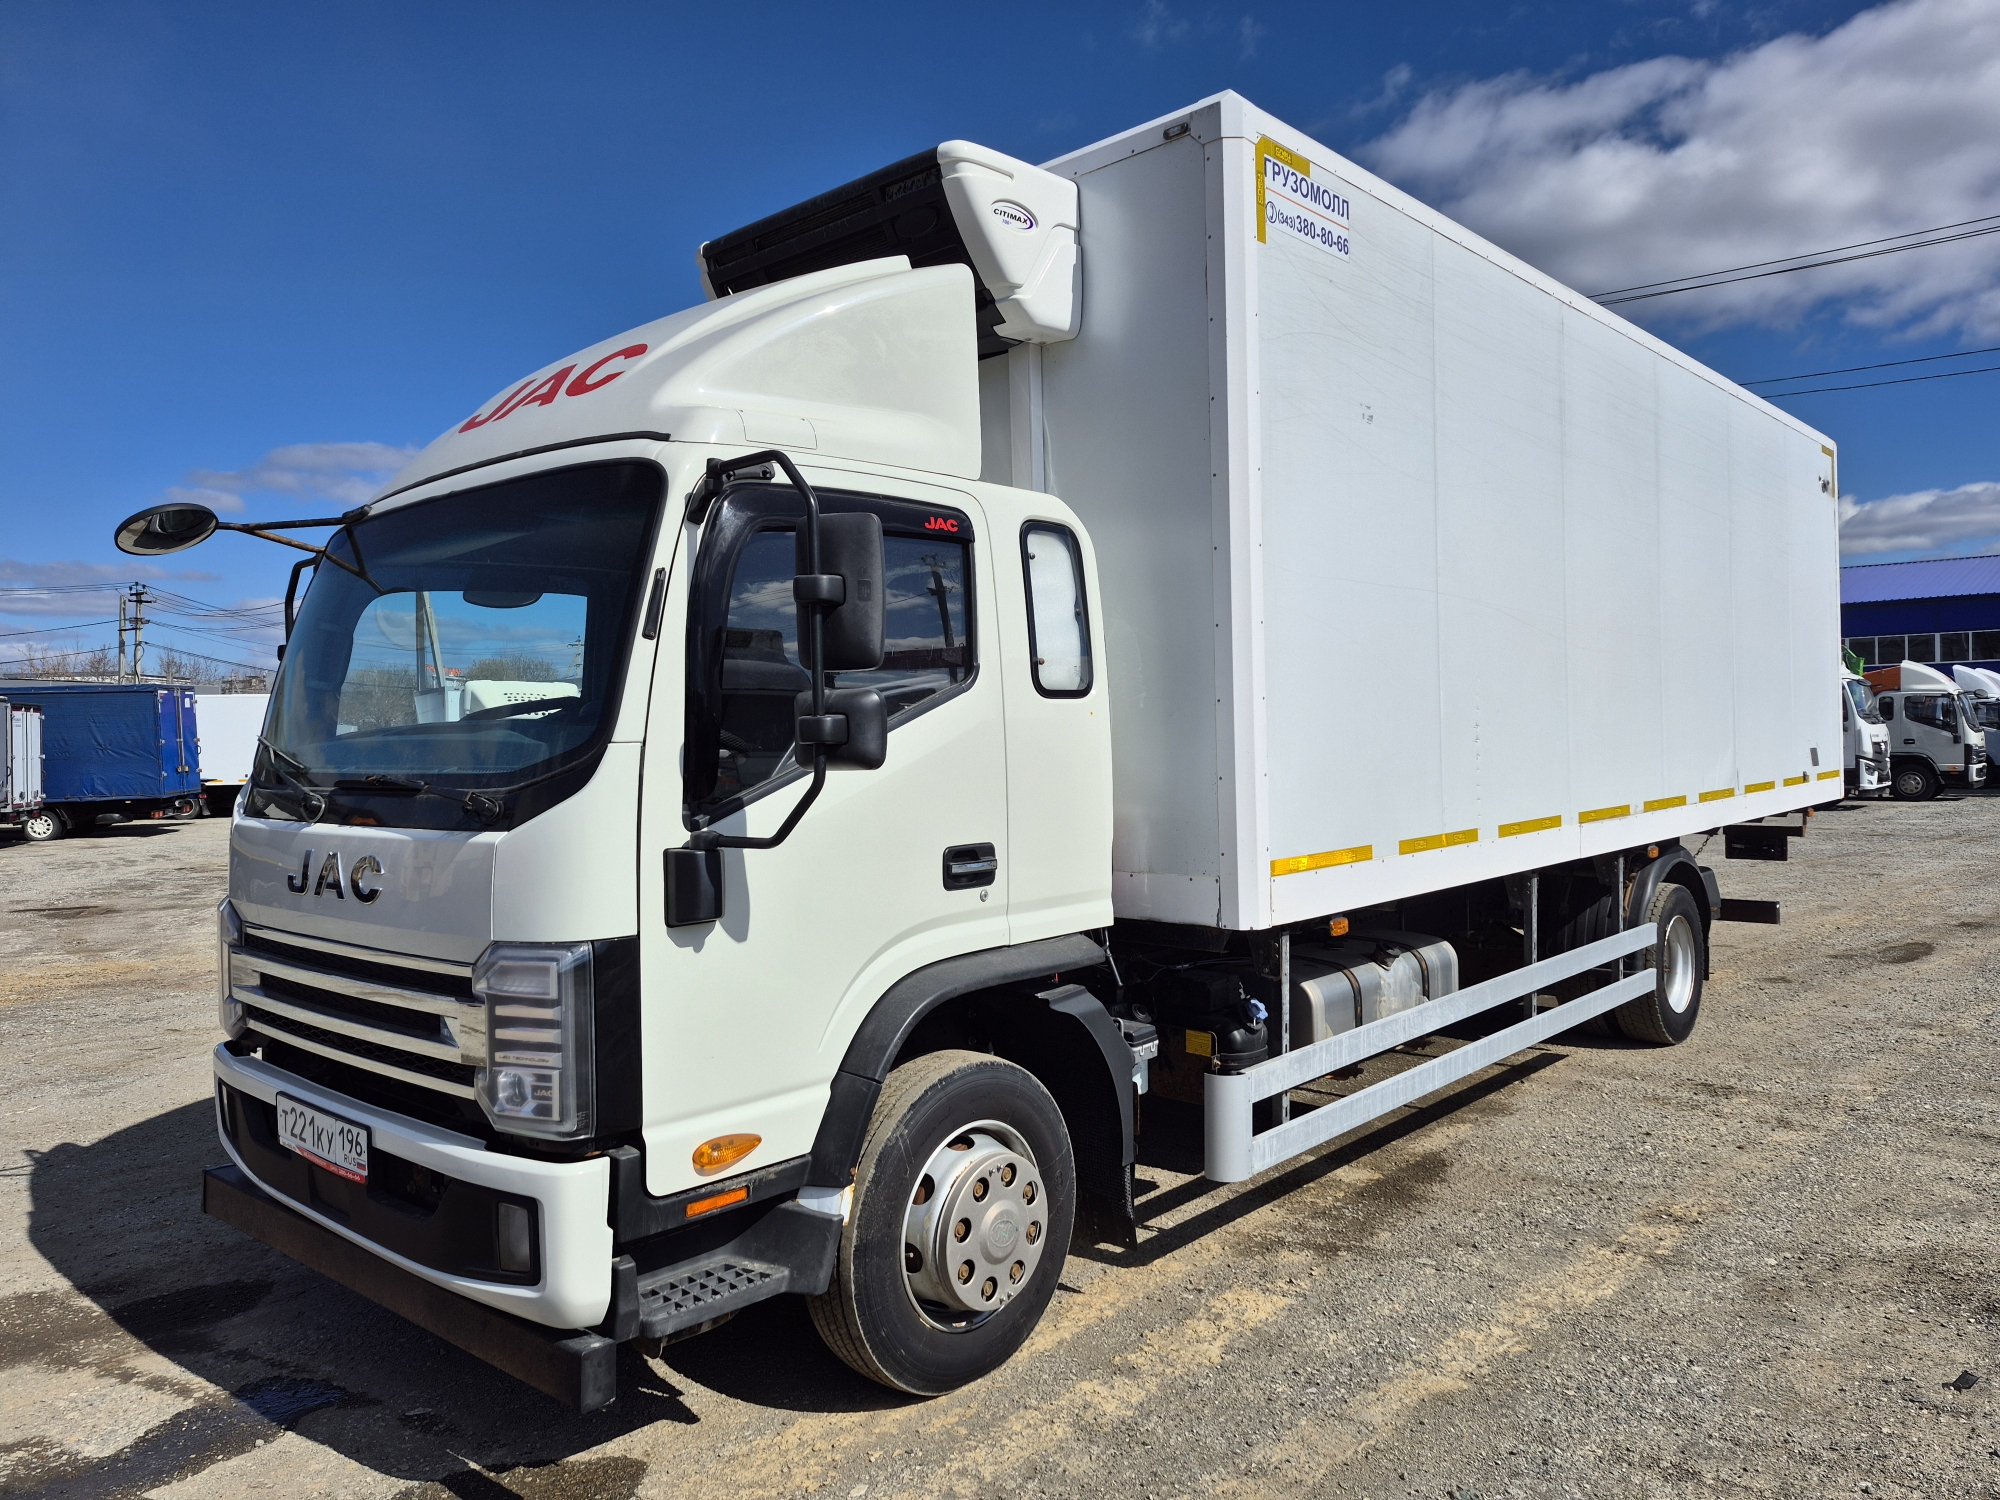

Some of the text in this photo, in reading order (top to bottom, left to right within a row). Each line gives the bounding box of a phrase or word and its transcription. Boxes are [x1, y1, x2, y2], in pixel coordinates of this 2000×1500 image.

[1264, 157, 1349, 220] ГРУЗОМОЛЛ
[993, 208, 1028, 225] CITIMAX
[458, 343, 648, 434] JAC
[924, 516, 959, 532] JAC
[287, 848, 385, 905] JAC
[338, 1126, 363, 1157] 196
[343, 1154, 357, 1167] RUS
